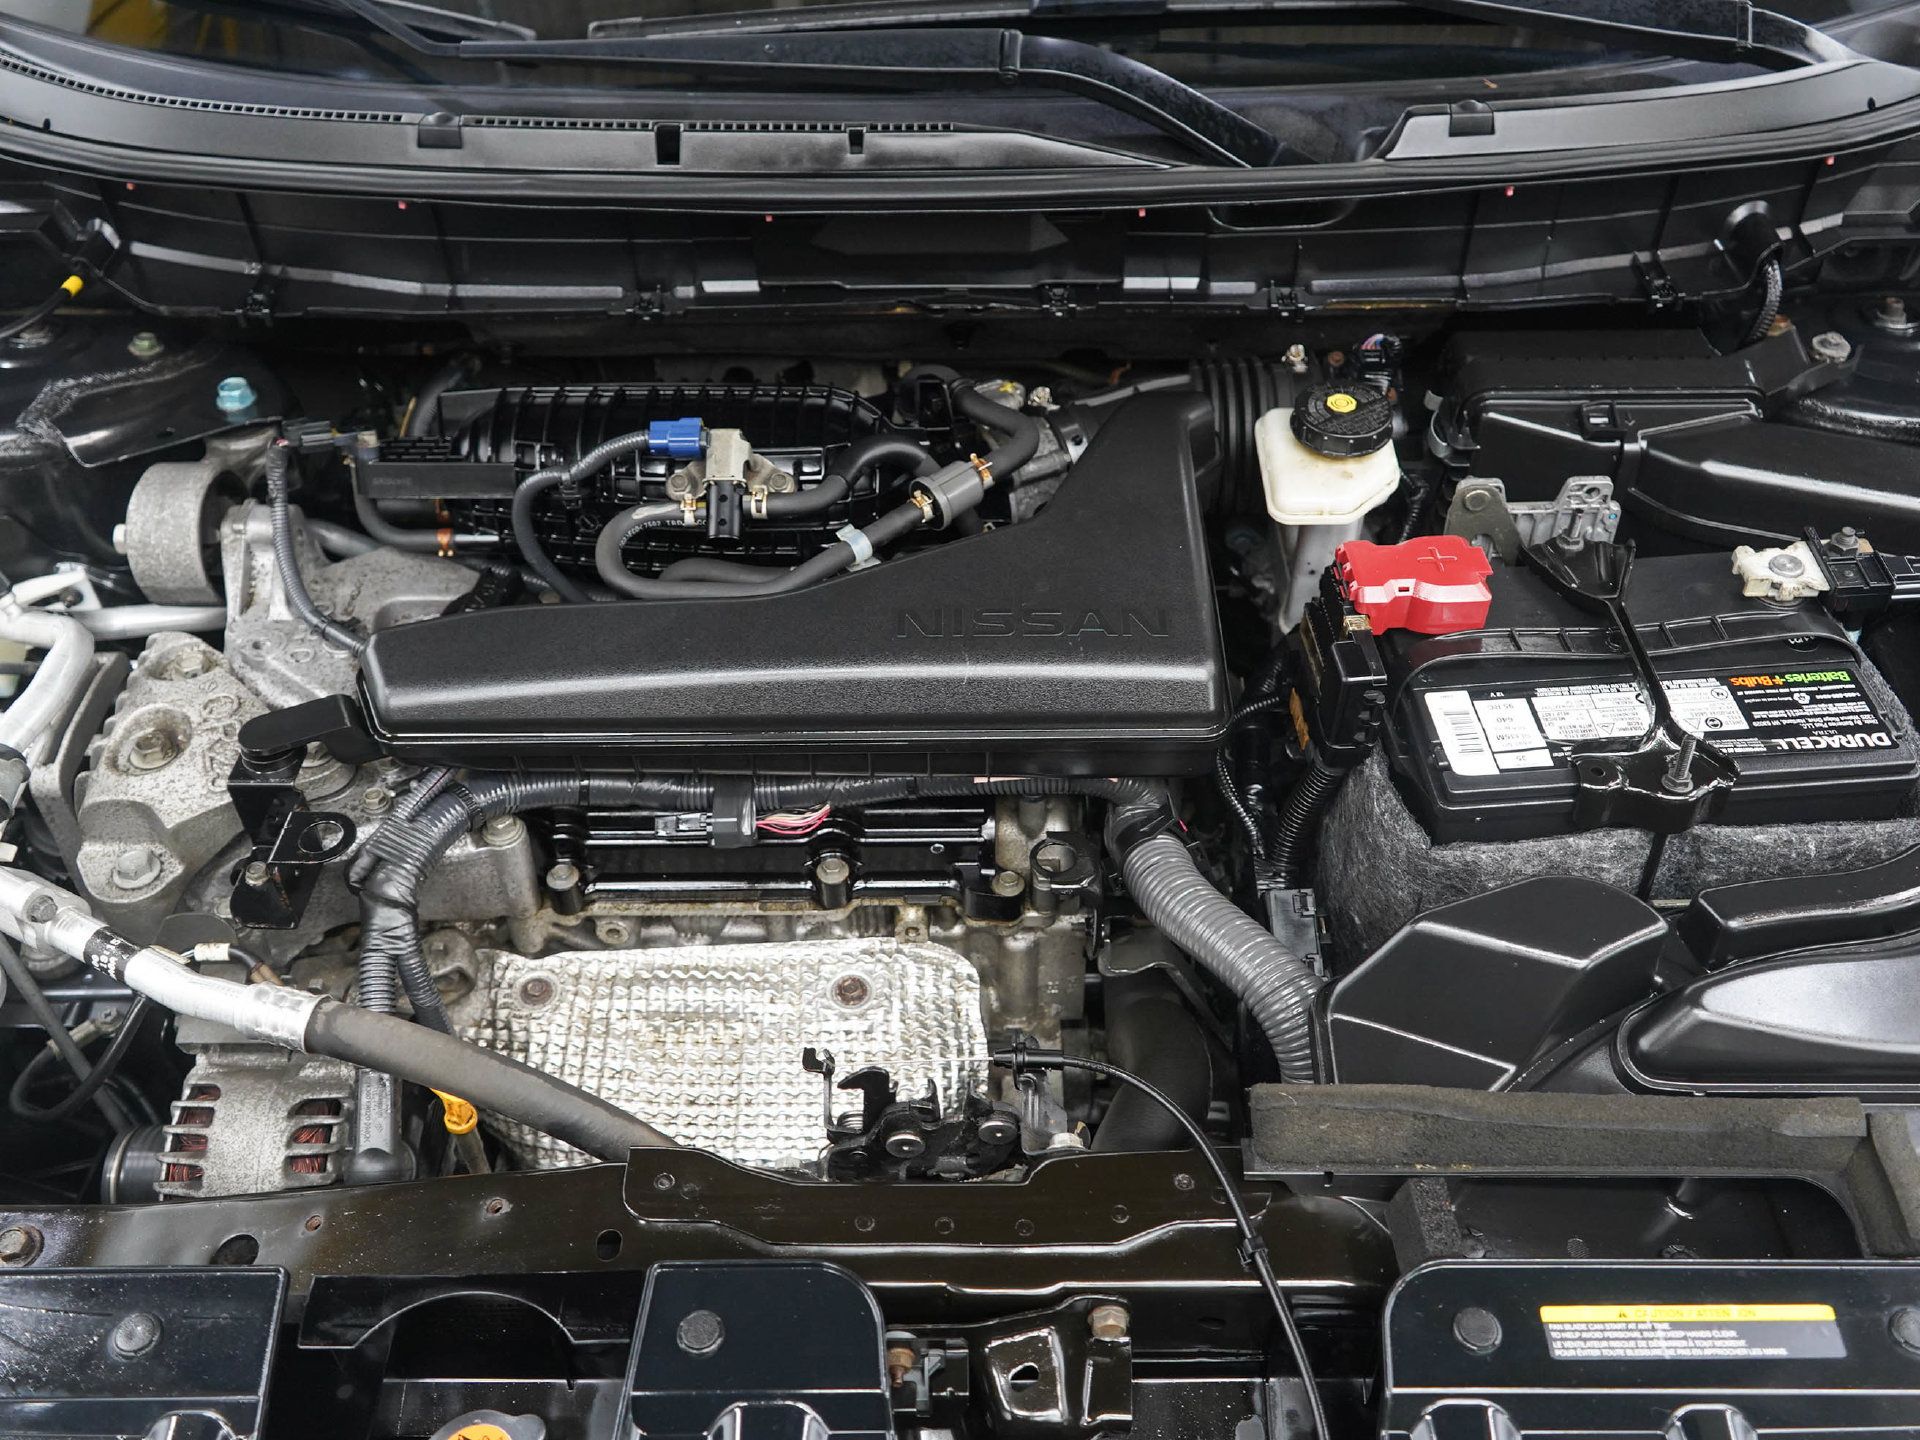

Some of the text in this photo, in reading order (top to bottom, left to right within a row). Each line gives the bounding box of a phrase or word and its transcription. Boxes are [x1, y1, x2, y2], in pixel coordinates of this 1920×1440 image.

[897, 607, 1168, 637] NISSAN
[1771, 732, 1892, 749] DURACELL
[1696, 1308, 1757, 1318] ATTENON
